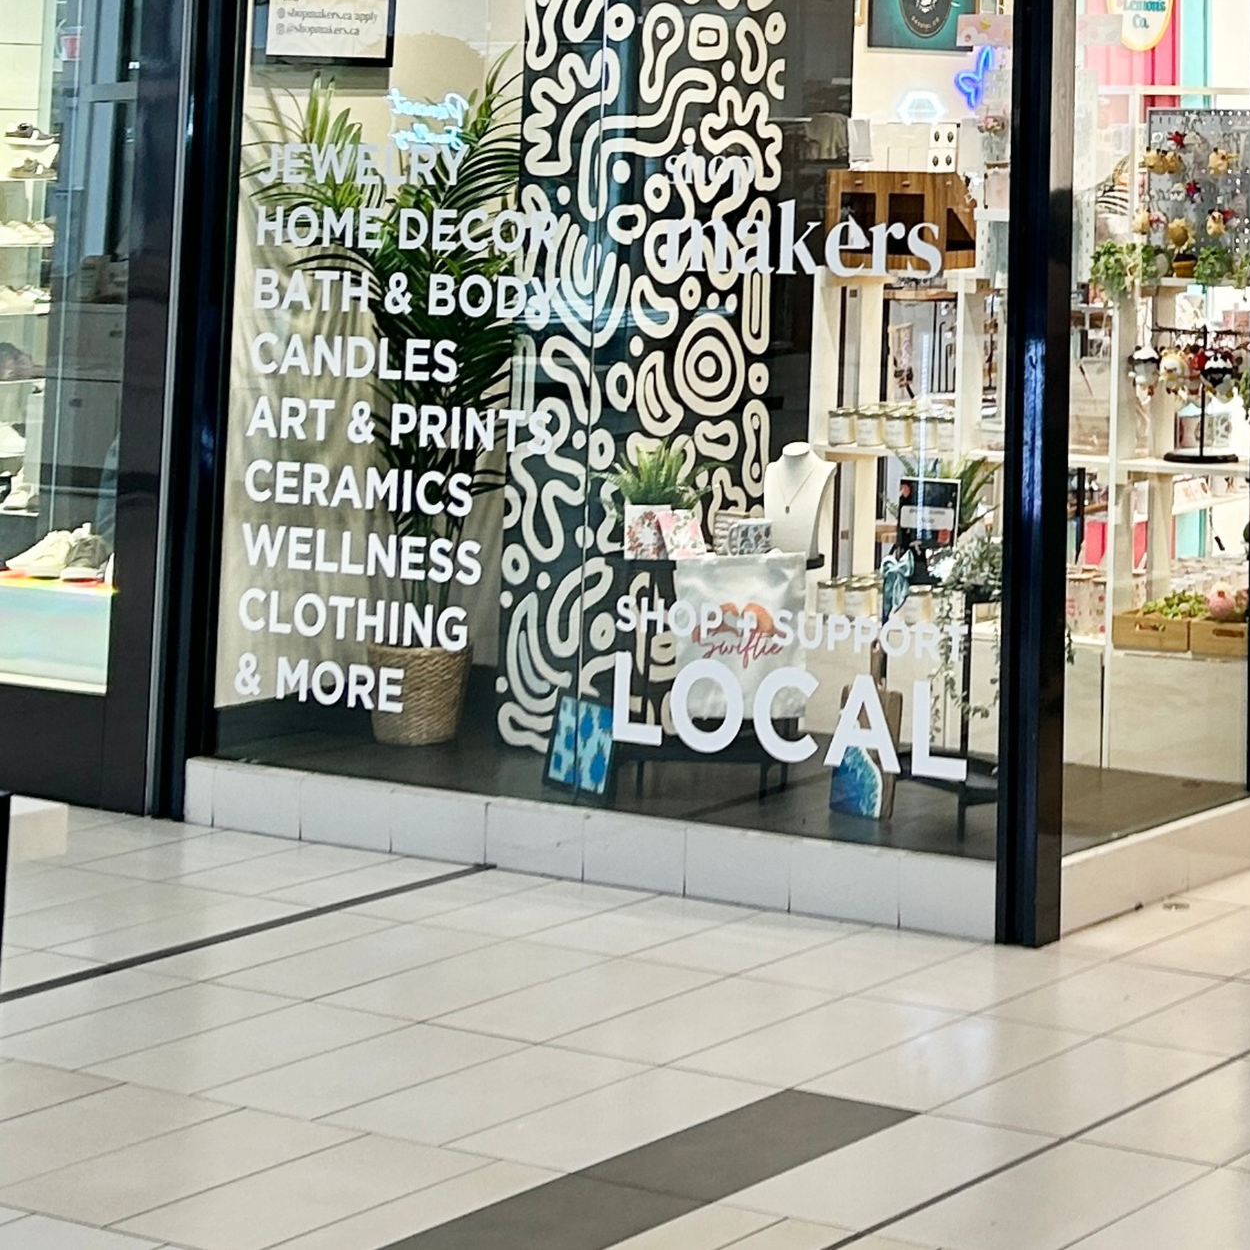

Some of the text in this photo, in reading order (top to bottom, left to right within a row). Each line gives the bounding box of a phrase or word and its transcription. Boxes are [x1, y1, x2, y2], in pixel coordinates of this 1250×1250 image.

[257, 141, 470, 186] JEWELRY
[664, 145, 757, 196] shop
[255, 205, 560, 250] HOME DECOR
[663, 199, 944, 279] makers
[253, 268, 561, 319] BATH & BODY
[250, 332, 459, 382] CANDLES
[246, 396, 553, 455] ART & PRINTS
[244, 459, 473, 517] CERAMICS
[242, 522, 482, 585] WELLNESS
[238, 588, 468, 652] CLOTHING
[615, 594, 723, 639] SHOP
[774, 611, 970, 661] SUPPORT
[234, 652, 405, 714] & MORE
[612, 650, 968, 782] LOCAL
